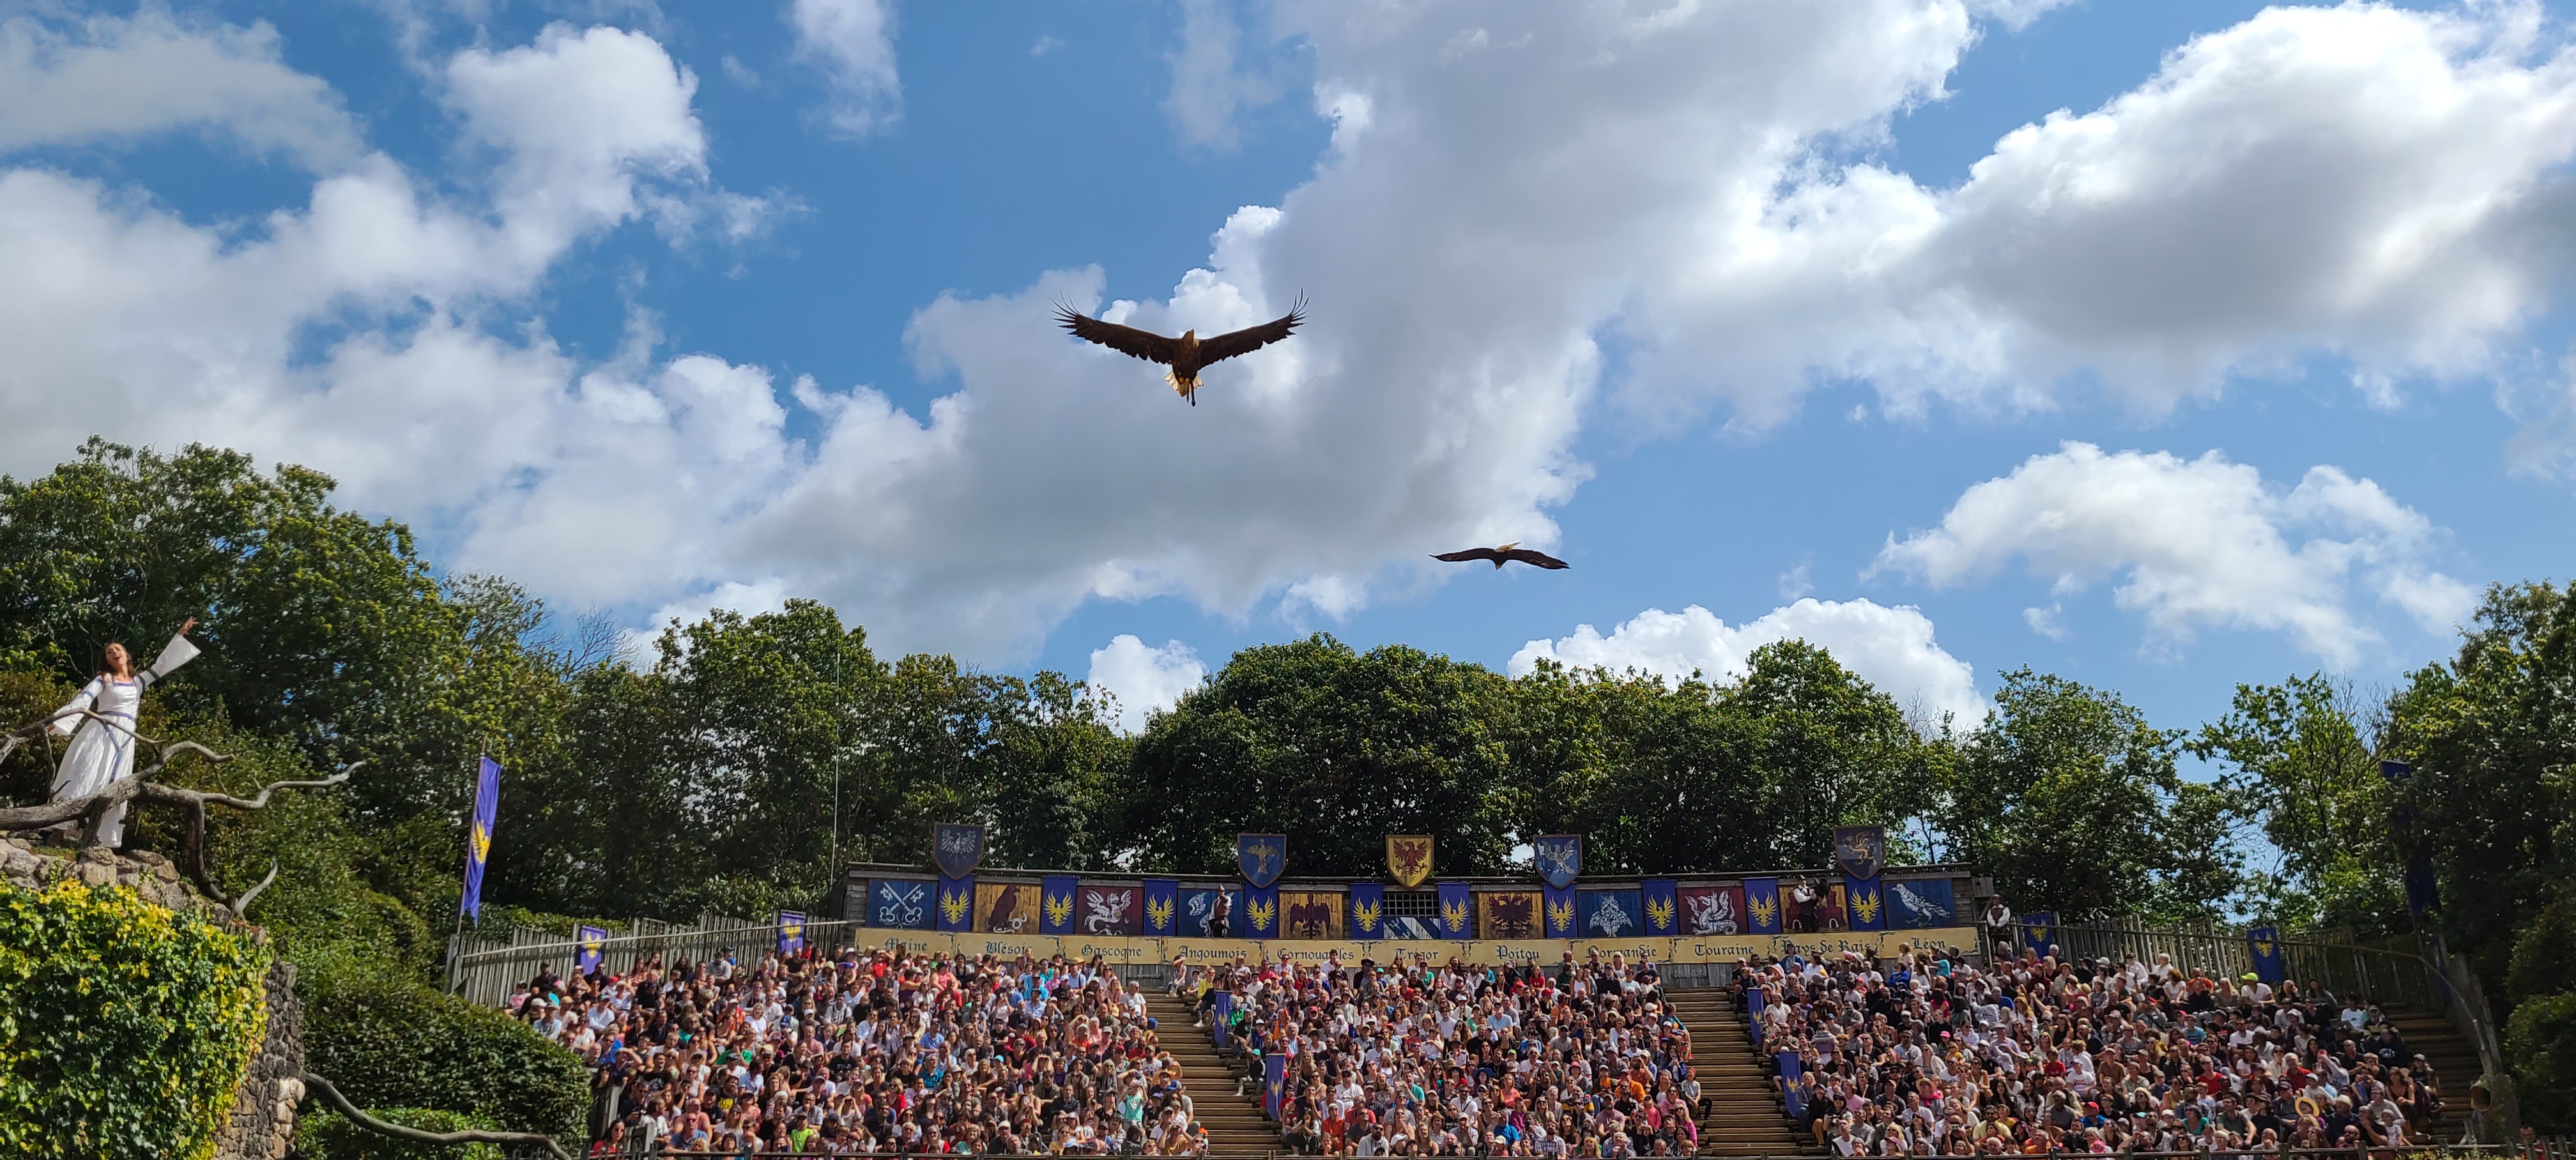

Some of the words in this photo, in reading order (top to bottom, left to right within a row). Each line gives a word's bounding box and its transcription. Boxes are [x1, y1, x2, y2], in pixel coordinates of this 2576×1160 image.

[985, 941, 1032, 954] Blésoi
[1694, 943, 1754, 956] Touraine
[1820, 940, 1833, 953] de
[1911, 937, 1945, 949] Léon
[1081, 944, 1142, 961] Gascogne
[1178, 945, 1246, 963] Angoumois
[1277, 947, 1354, 960] Cornouales
[1496, 945, 1540, 959] Poitou
